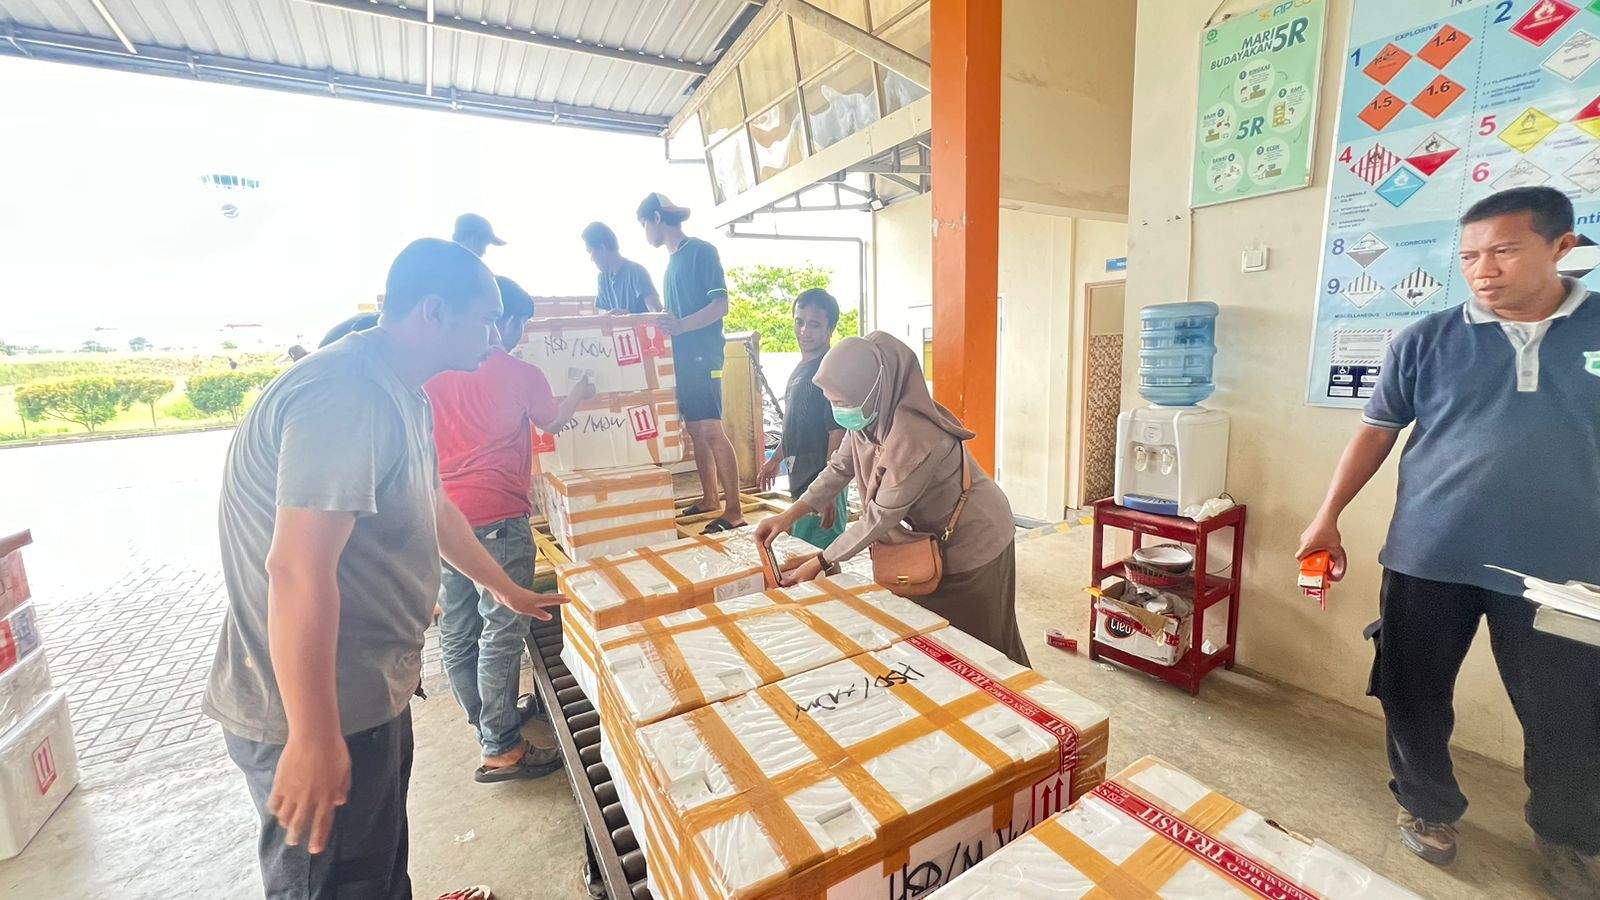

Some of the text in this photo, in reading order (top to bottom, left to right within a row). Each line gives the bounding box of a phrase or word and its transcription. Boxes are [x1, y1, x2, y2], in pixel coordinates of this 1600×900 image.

[1493, 0, 1513, 24] 2
[1241, 28, 1275, 50] MARI
[1272, 17, 1309, 52] 5R
[1394, 23, 1439, 42] EXPLOSIVE
[1432, 31, 1457, 46] 1.4
[1210, 41, 1273, 70] BUDAYAKAN
[1350, 48, 1360, 67] 1
[1426, 81, 1450, 96] 1.6
[1370, 96, 1392, 110] 1.5
[1236, 116, 1264, 140] 5R
[1478, 115, 1496, 136] 5
[1338, 146, 1352, 164] 4
[1472, 162, 1490, 182] 6
[1332, 238, 1345, 256] 8
[1328, 278, 1340, 294] 9
[943, 655, 990, 688] TRANSIT
[1133, 801, 1228, 864] TRANSIT
